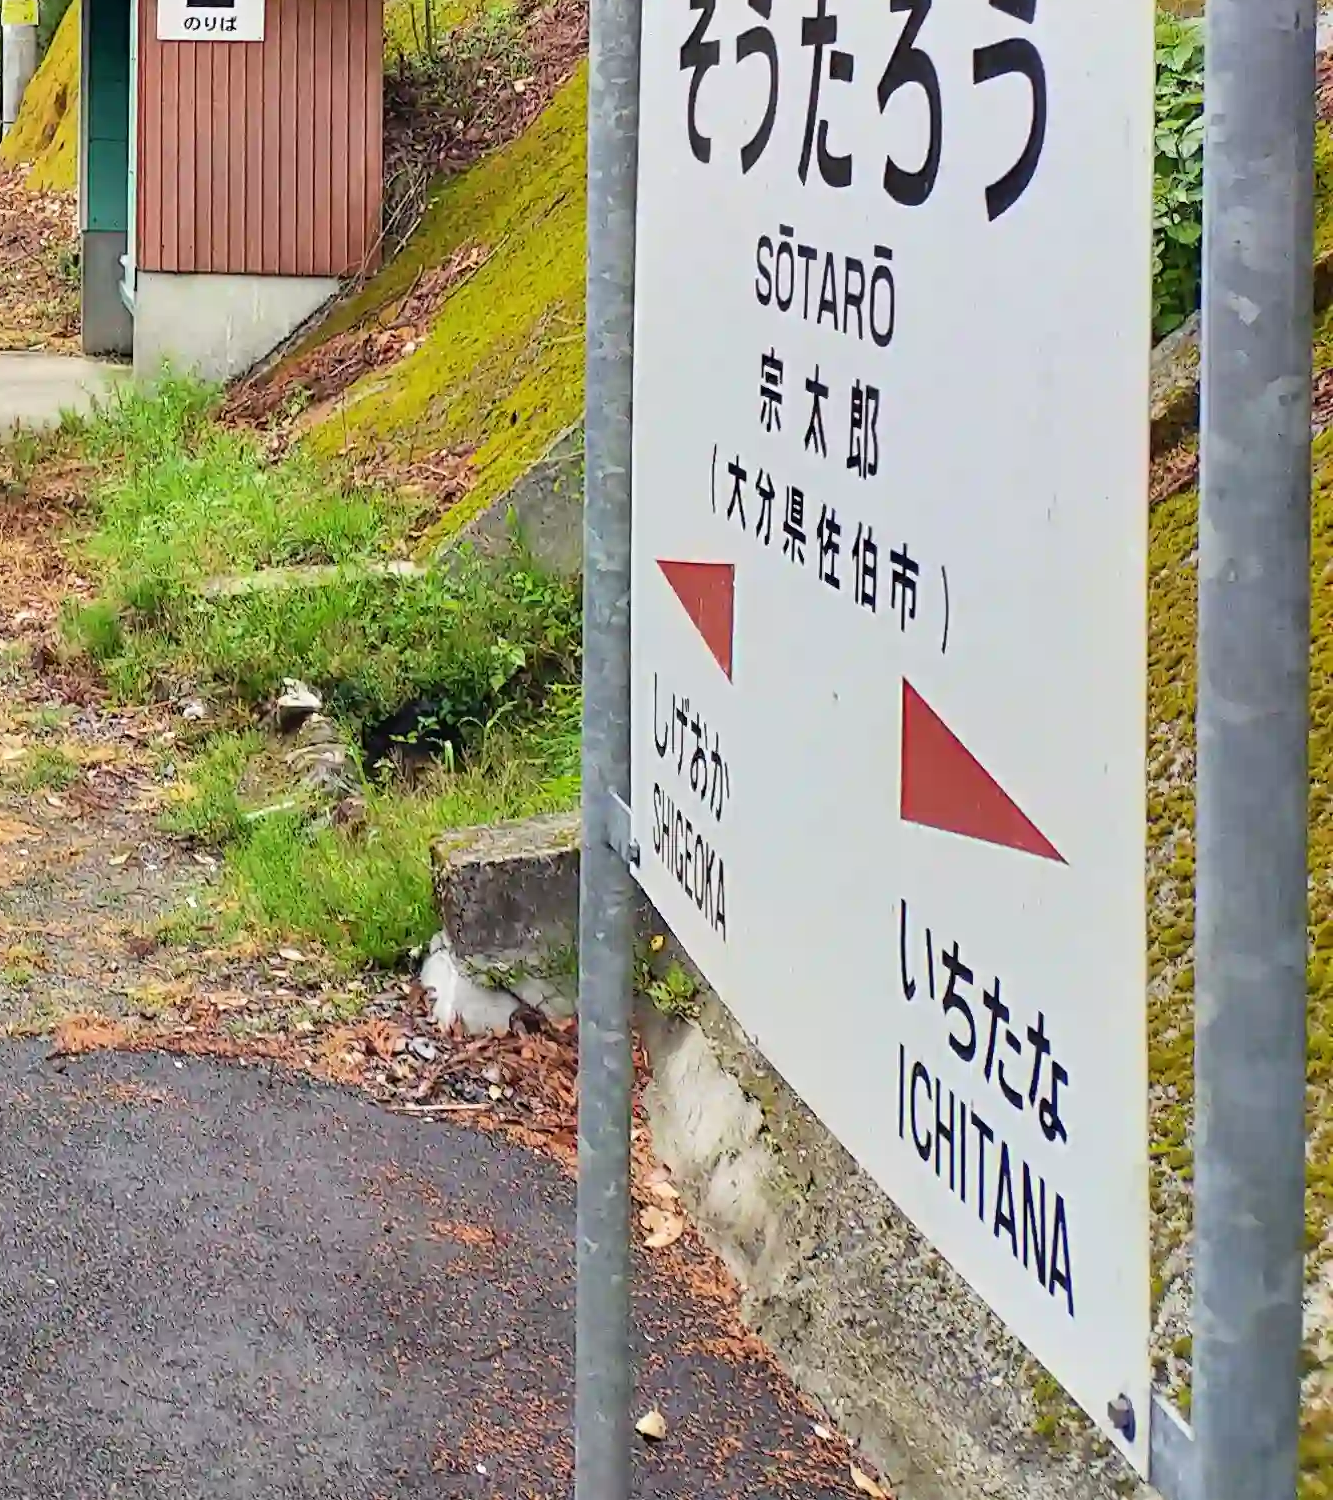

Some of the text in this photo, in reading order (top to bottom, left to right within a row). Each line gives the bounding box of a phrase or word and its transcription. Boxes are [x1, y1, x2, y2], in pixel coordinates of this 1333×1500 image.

[184, 16, 238, 32] のりば
[755, 224, 895, 348] SŌTARŌ
[759, 346, 881, 481] 宗太郎
[653, 671, 731, 824] しげおか
[652, 782, 728, 943] SHIGEOKA
[896, 897, 1070, 1146] いちたな
[898, 1042, 1076, 1319] ICHITANA
